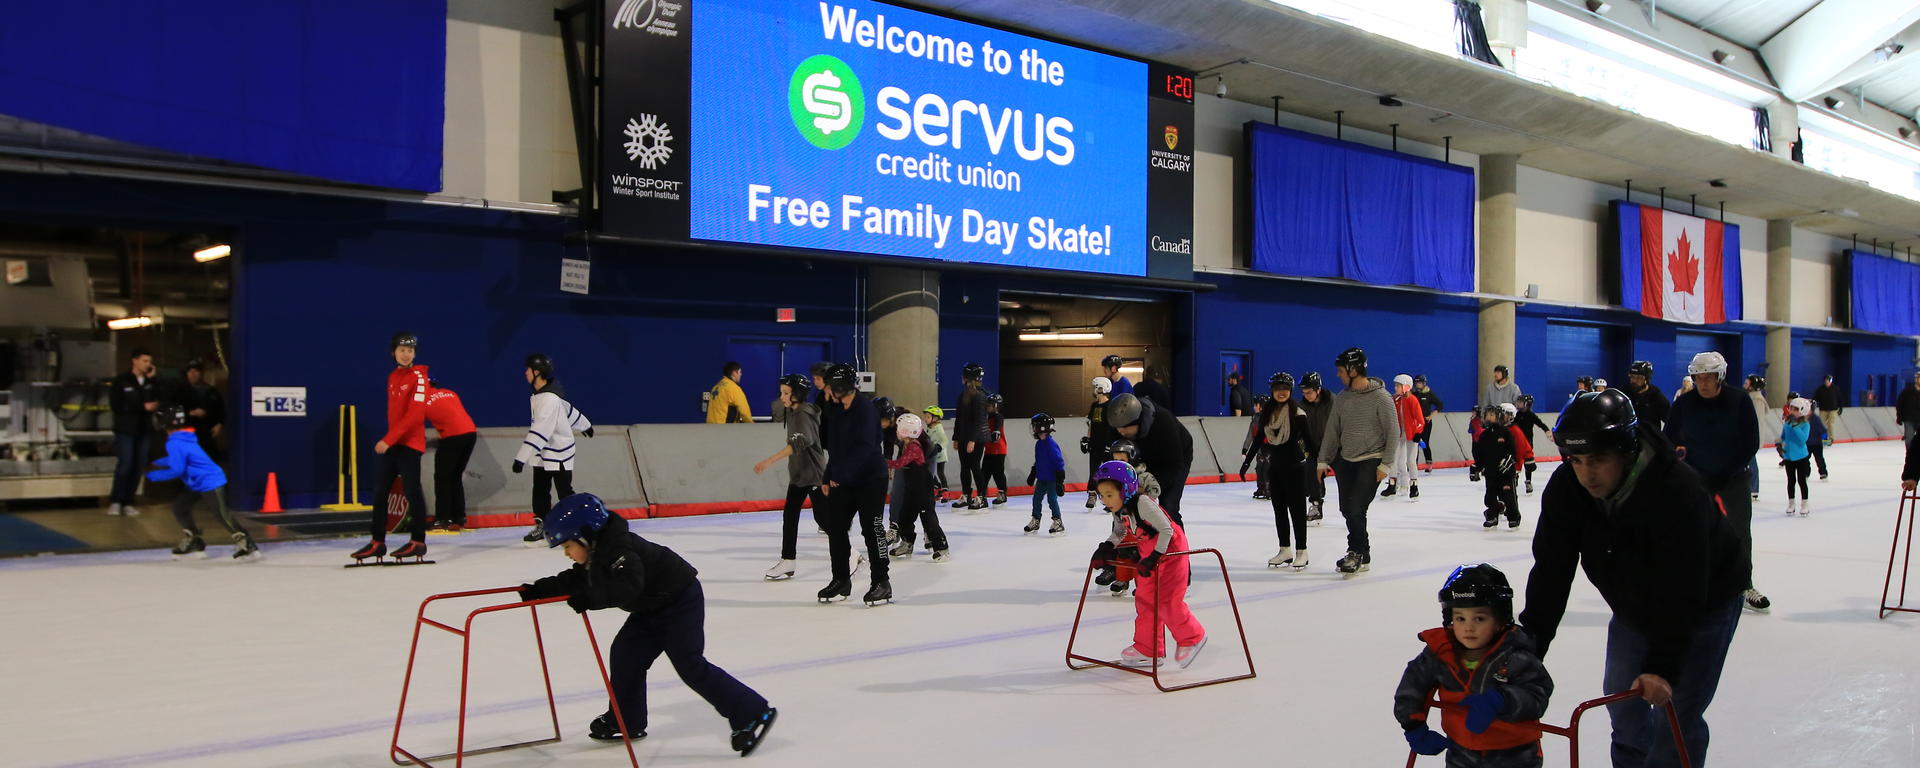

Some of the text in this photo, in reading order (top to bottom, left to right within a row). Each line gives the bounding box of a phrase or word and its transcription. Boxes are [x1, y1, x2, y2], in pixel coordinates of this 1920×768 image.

[820, 2, 1065, 86] Welcome to the
[1167, 75, 1192, 99] 1:20
[877, 86, 1075, 165] servus
[1151, 157, 1191, 172] CALGARY
[1152, 150, 1182, 160] UNIVERSITY
[876, 152, 1021, 193] credit union
[613, 186, 680, 200] Winter Sport Institute
[748, 184, 1111, 256] Free Family Day Skate!
[1151, 235, 1191, 254] Canada
[266, 397, 306, 412] 1:45
[388, 493, 405, 516] STO
